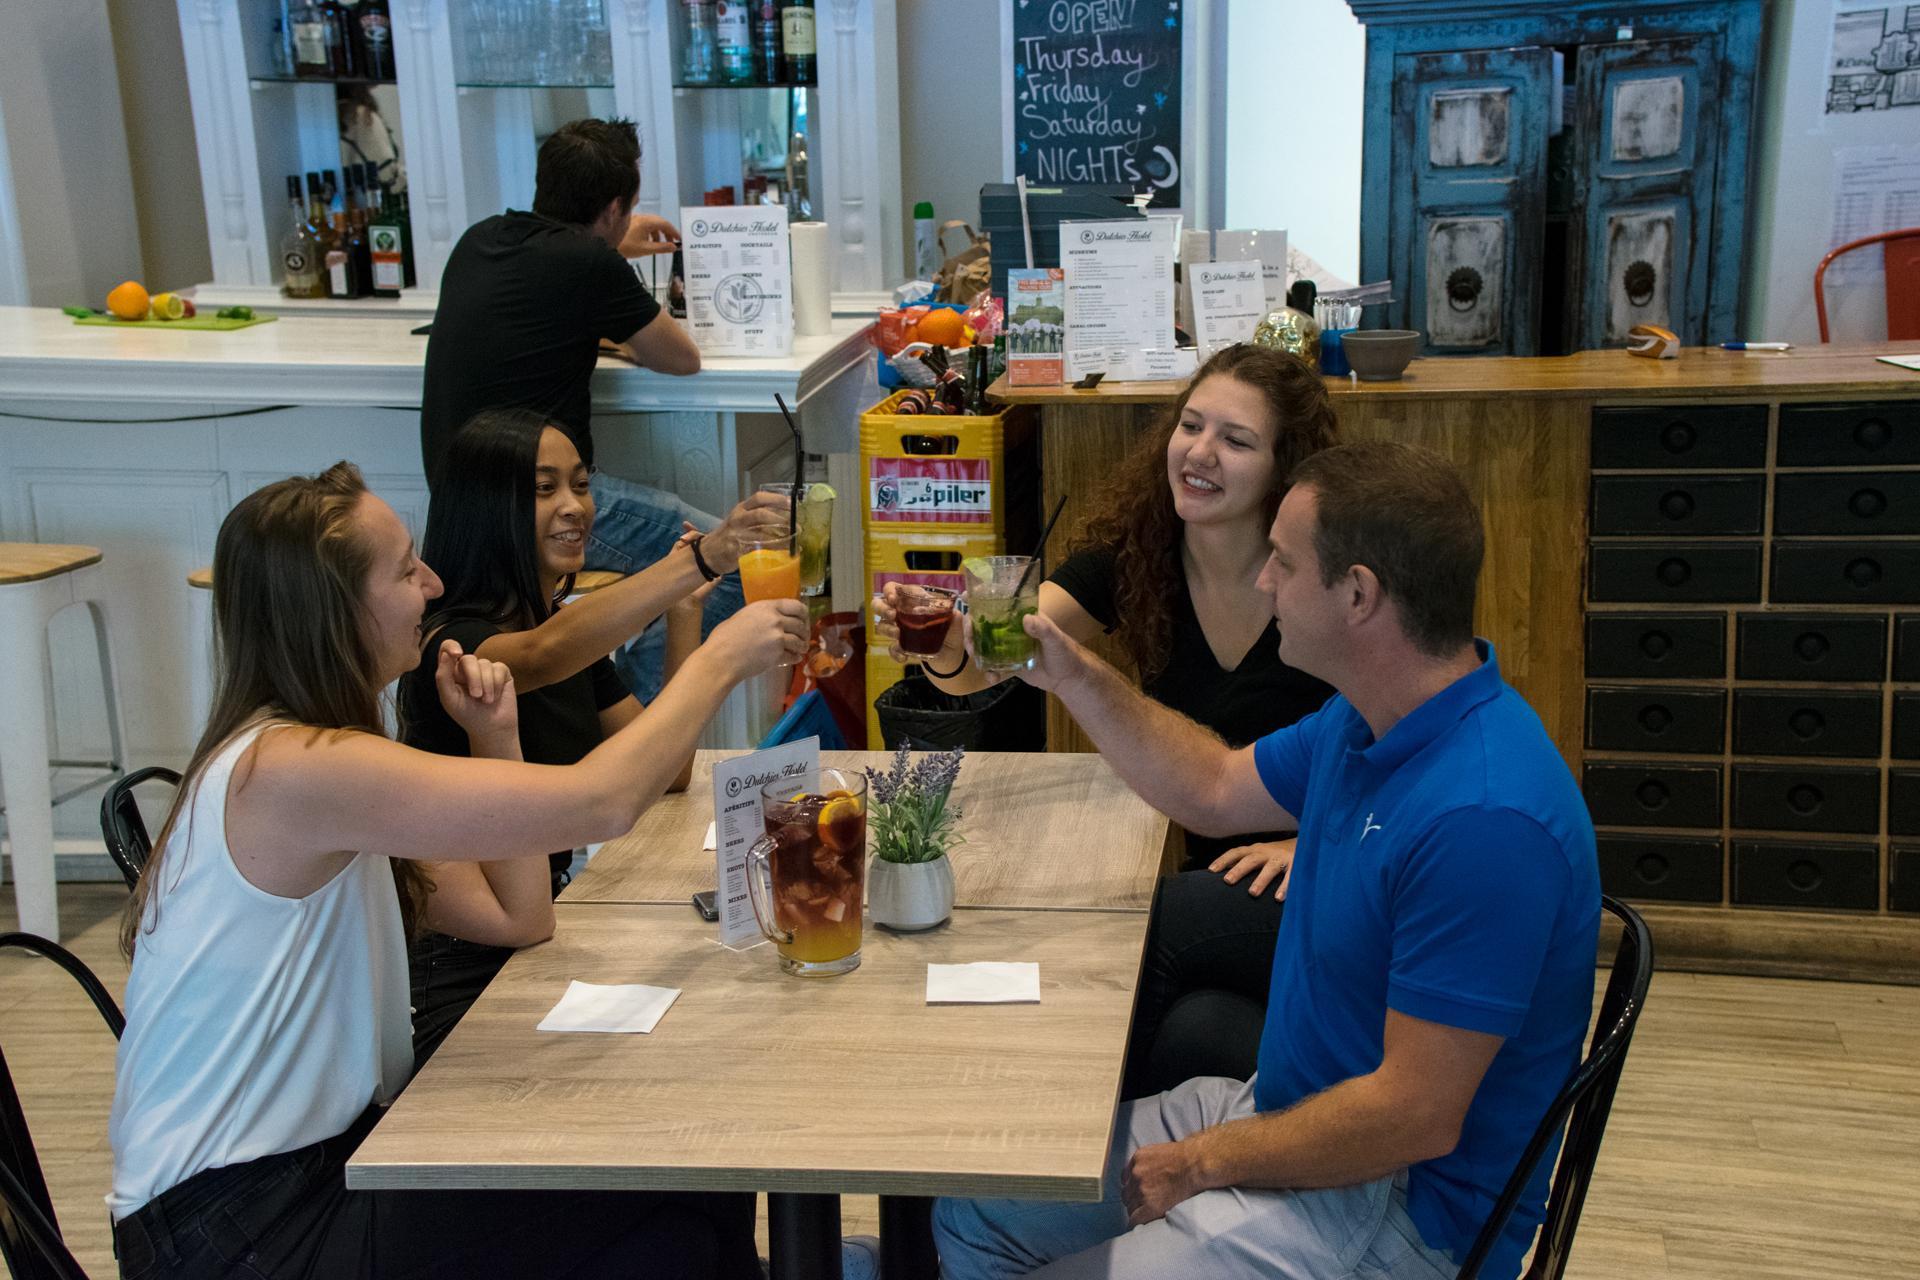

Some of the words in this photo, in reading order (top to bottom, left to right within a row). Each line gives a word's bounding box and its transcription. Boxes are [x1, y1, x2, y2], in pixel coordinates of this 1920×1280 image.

[1019, 34, 1159, 88] Thursday
[1026, 69, 1112, 121] Friday
[1022, 104, 1156, 156] Saturday
[743, 771, 780, 790] Dutchies
[781, 761, 808, 776] Hostel
[727, 893, 748, 904] MIXES
